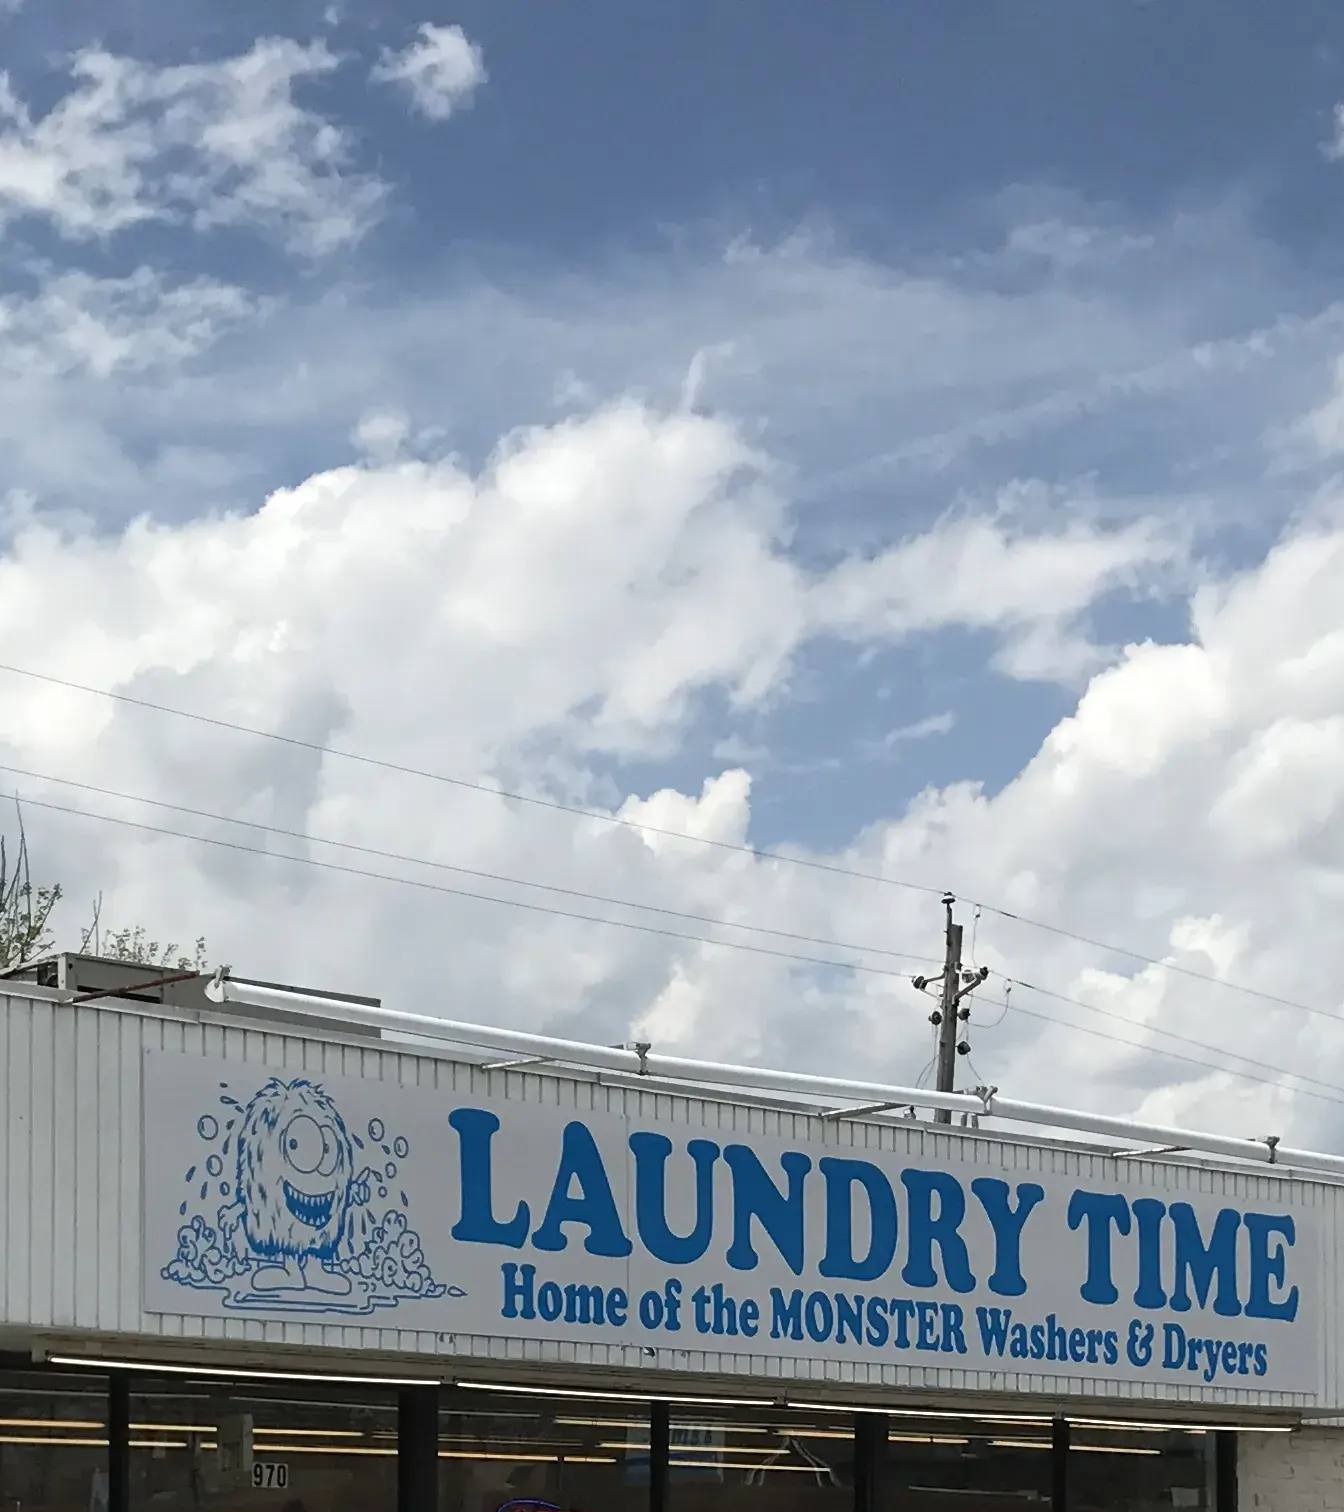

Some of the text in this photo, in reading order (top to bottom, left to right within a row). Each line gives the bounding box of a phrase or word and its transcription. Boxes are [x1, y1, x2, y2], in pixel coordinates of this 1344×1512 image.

[449, 1108, 1299, 1319] LAUNDRY TIME
[501, 1262, 1268, 1381] Home of the MONSTER Washers & Dryers
[253, 1463, 286, 1488] 970
